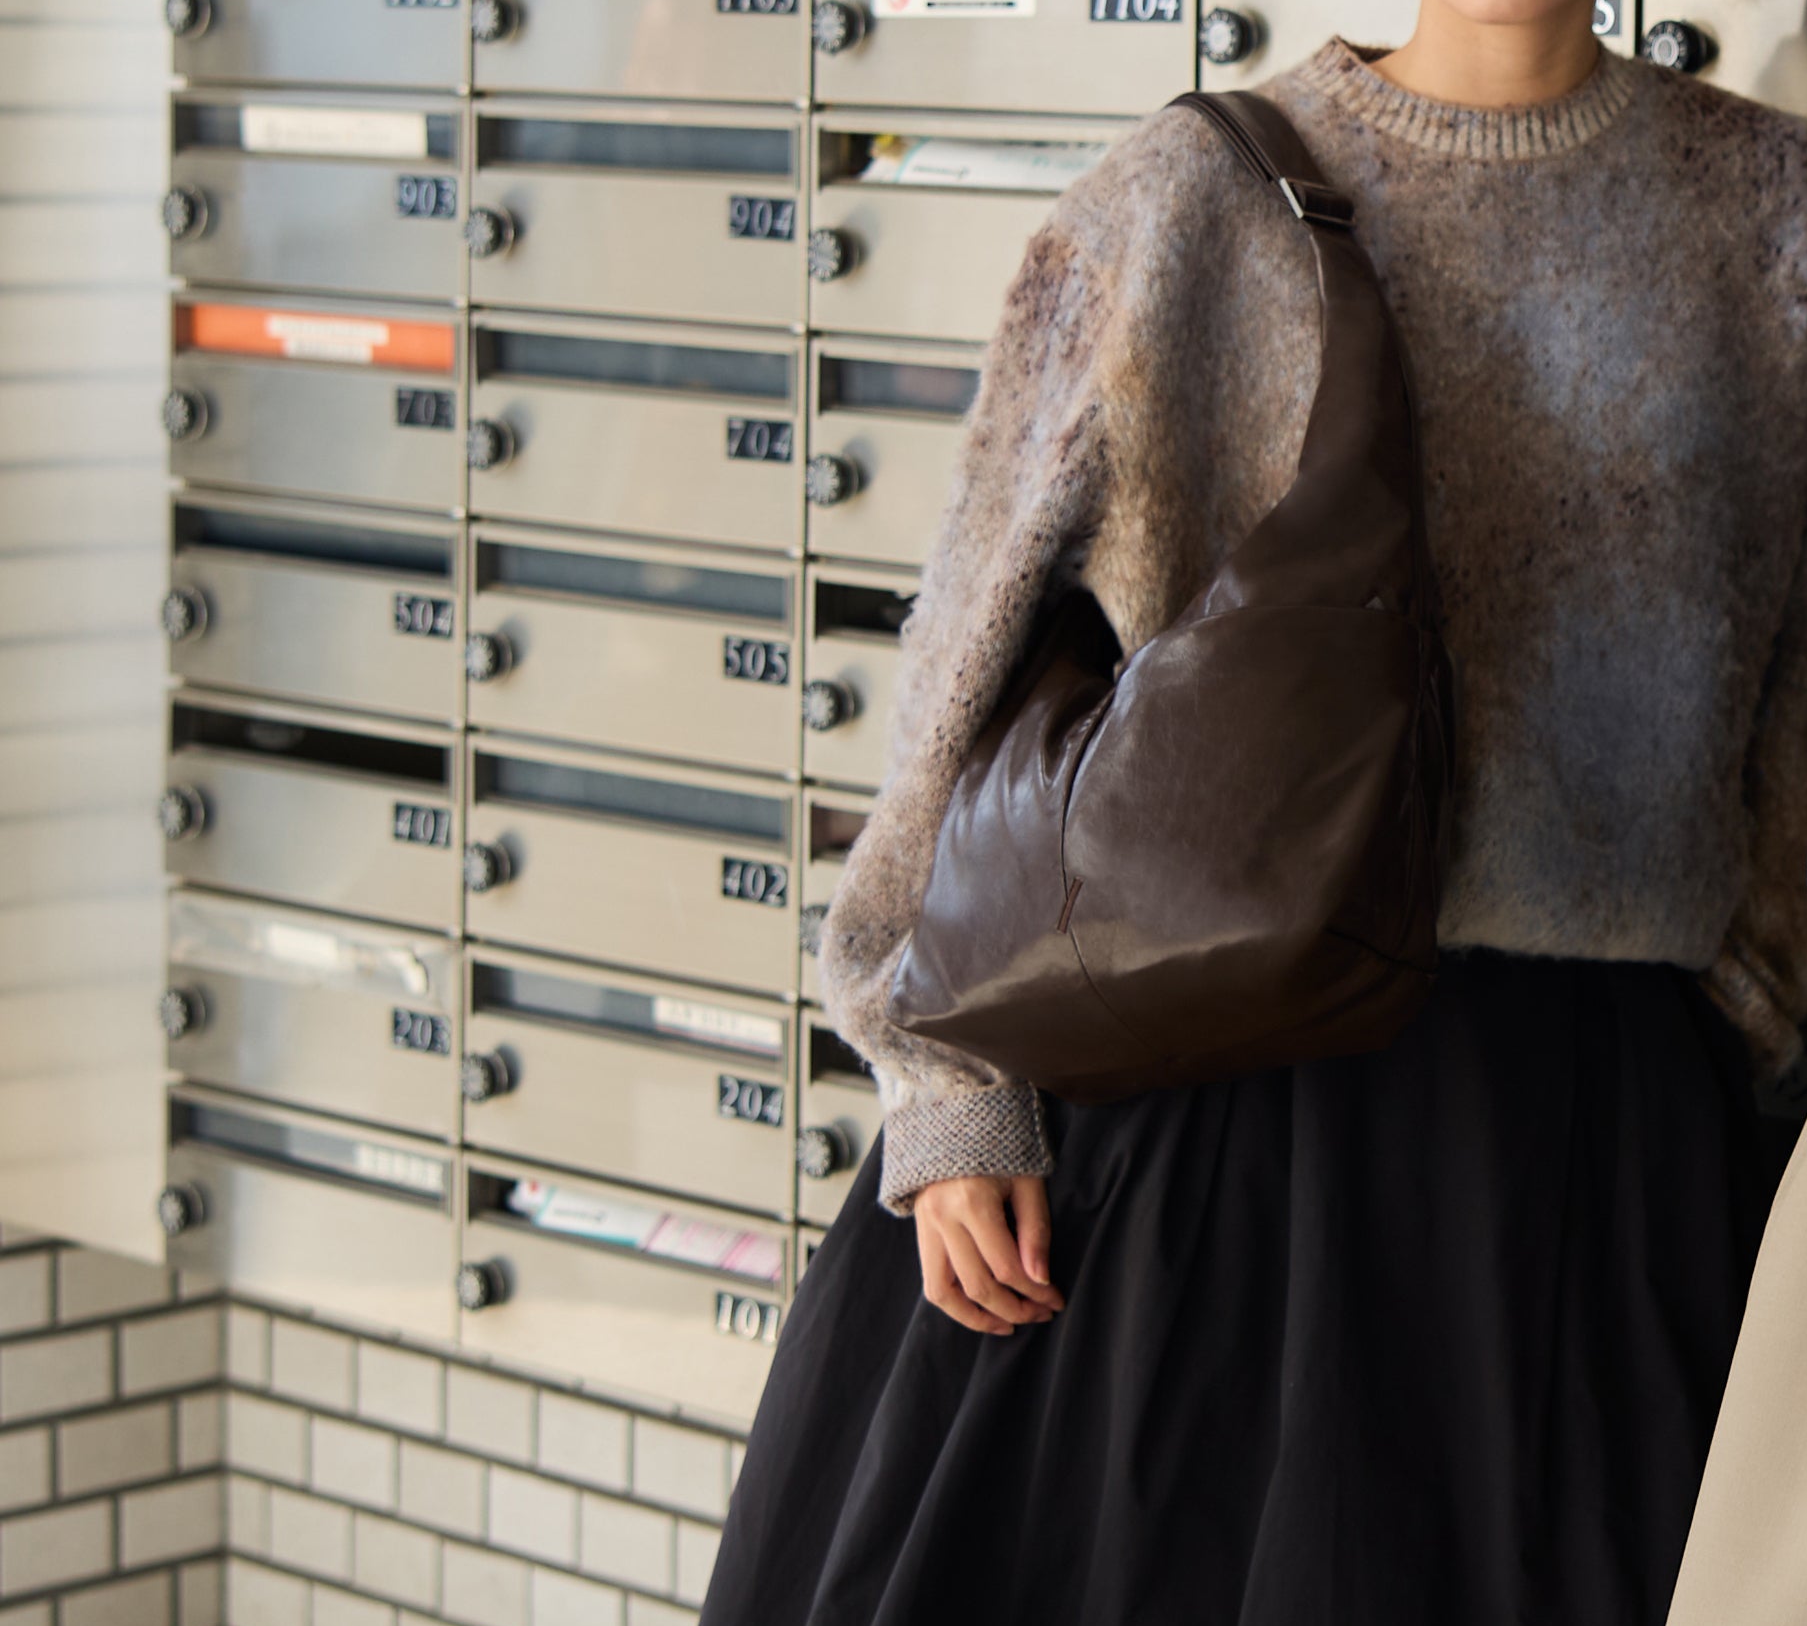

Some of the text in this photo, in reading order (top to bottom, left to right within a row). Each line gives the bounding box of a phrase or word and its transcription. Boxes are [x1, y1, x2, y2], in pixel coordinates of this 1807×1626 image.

[397, 178, 456, 218] 903
[730, 198, 794, 239] 904
[728, 420, 791, 462] 704
[725, 639, 789, 685] 505
[724, 860, 787, 906] 402
[719, 1076, 783, 1127] 204
[716, 1293, 780, 1345] 101
